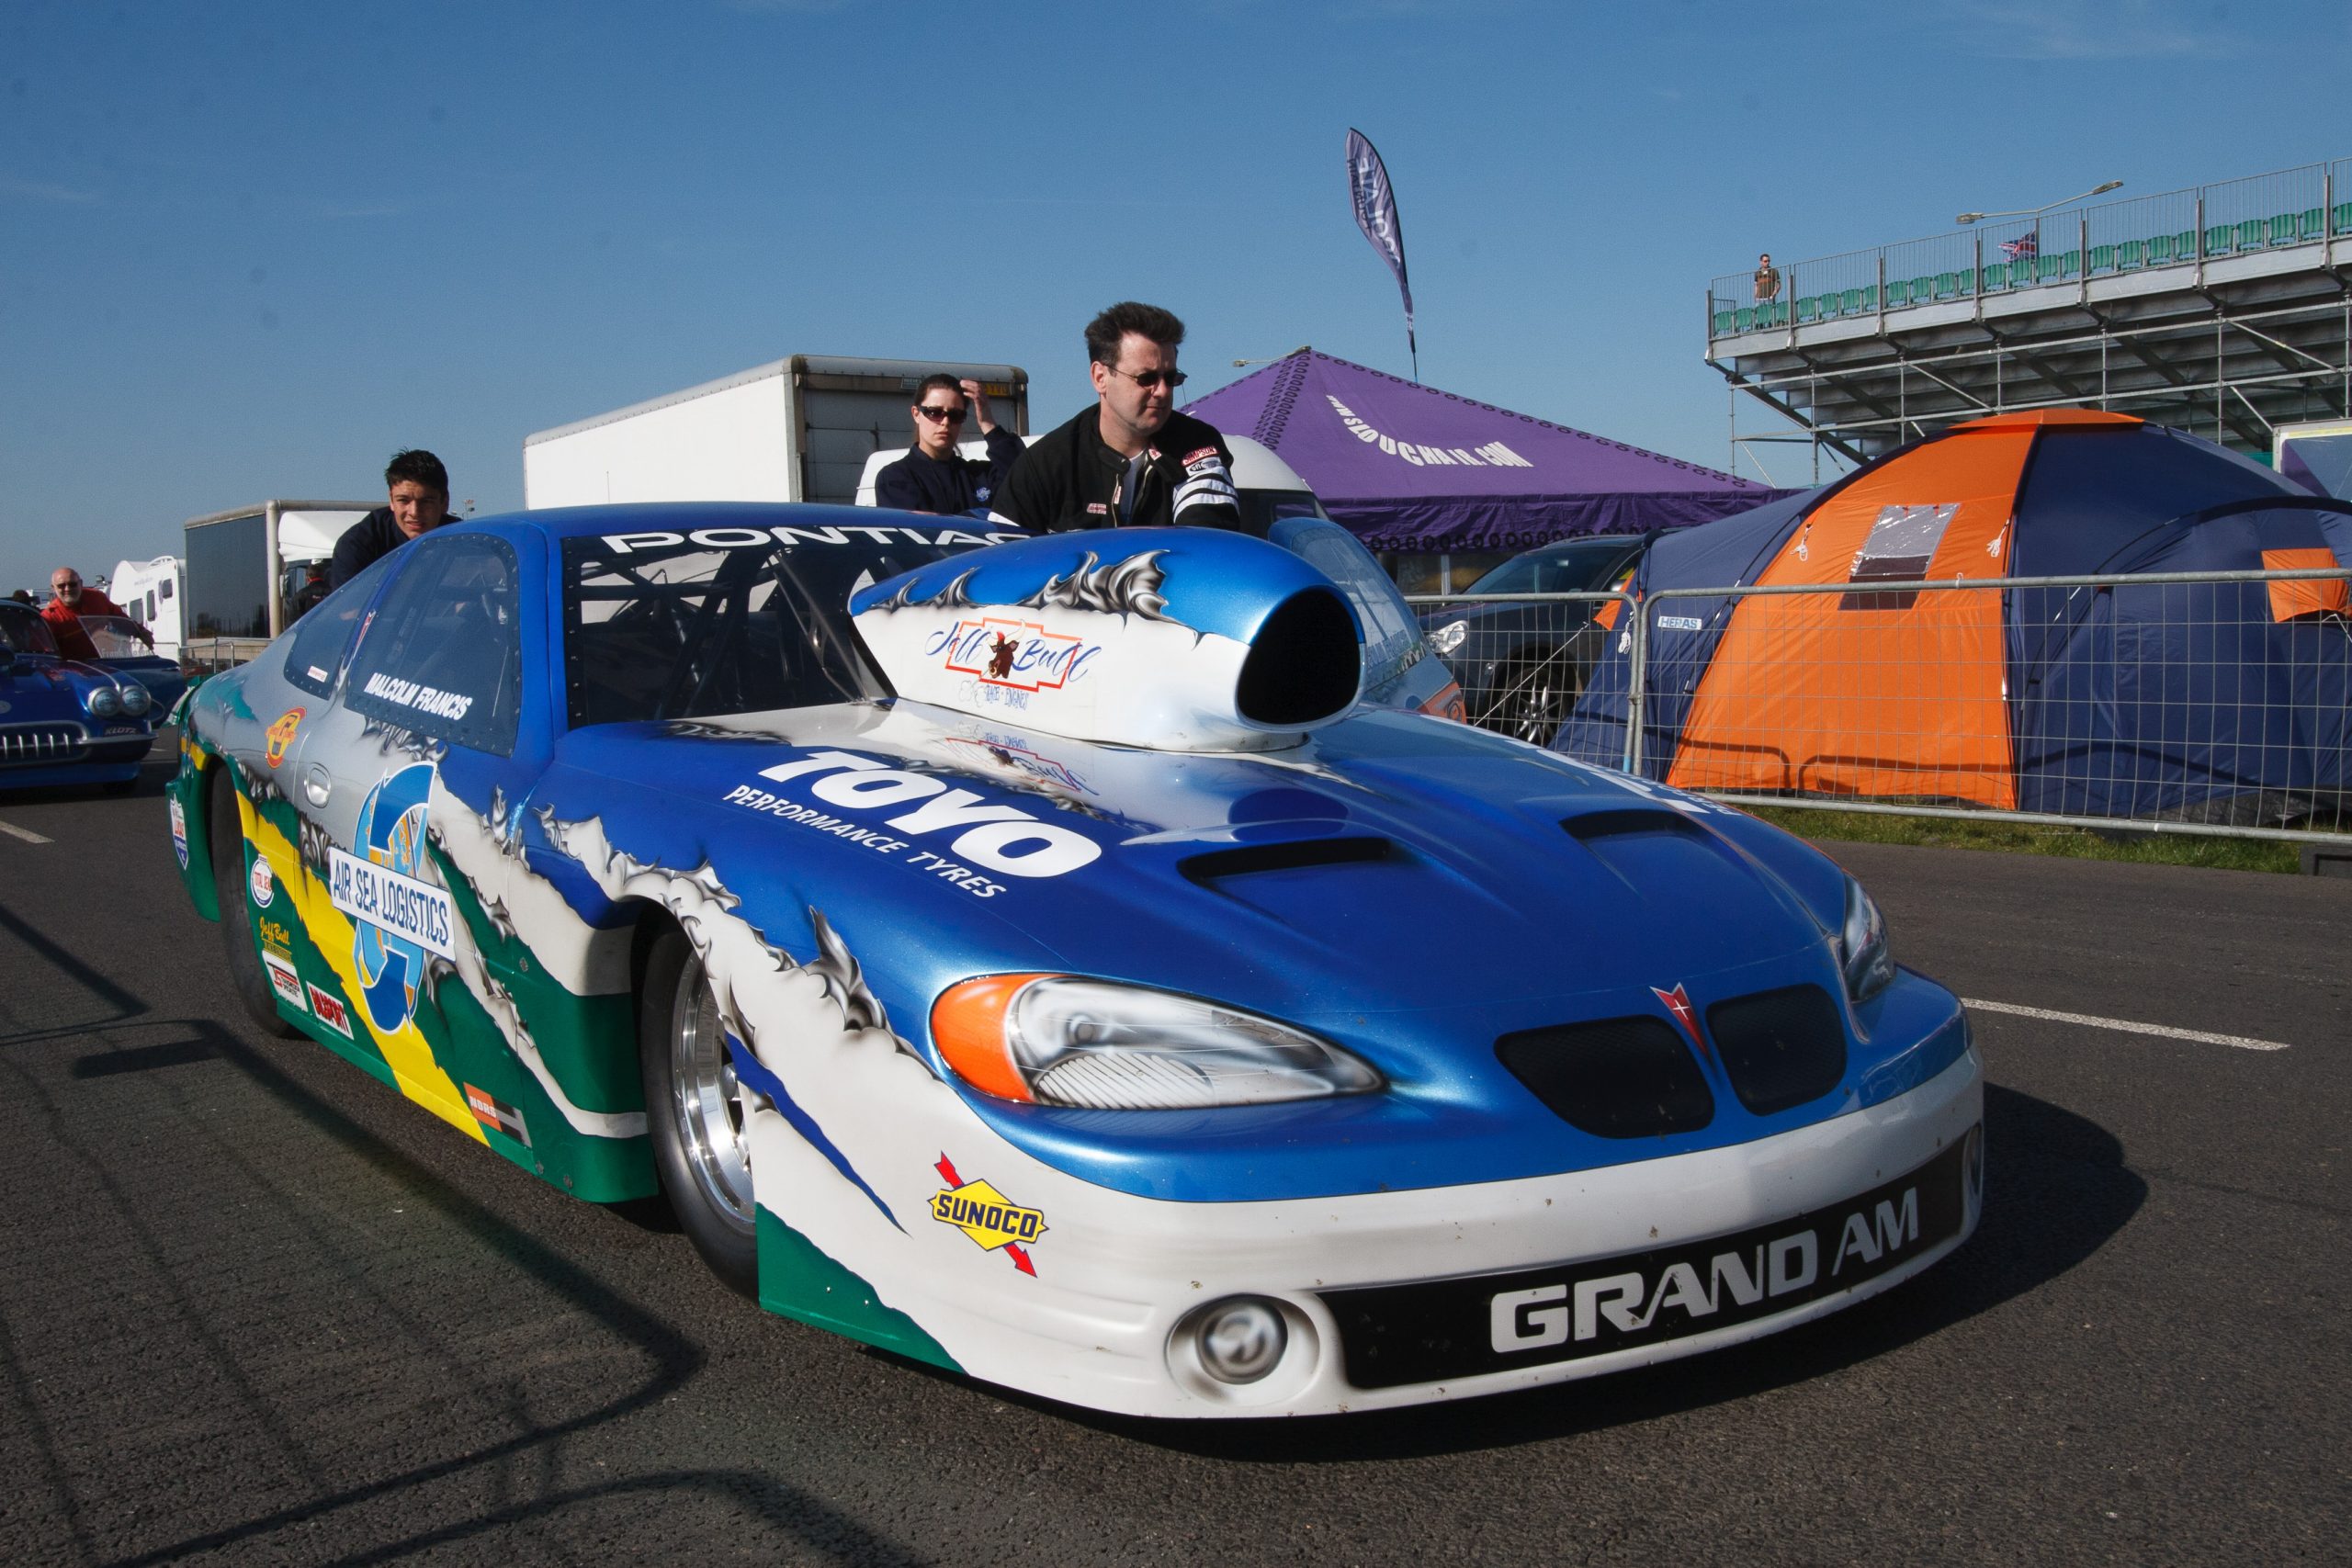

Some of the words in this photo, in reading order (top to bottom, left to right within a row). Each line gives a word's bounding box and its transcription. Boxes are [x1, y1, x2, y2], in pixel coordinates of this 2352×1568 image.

[1184, 446, 1216, 464] SIMPSON
[1660, 617, 1698, 629] HERAS
[1012, 639, 1102, 682] Bull
[364, 672, 421, 706] MALCOLM
[412, 686, 473, 721] FRANCIS
[105, 727, 137, 735] KLOTZ
[758, 750, 1102, 878] TOYO
[723, 784, 910, 854] PERFORMANCE
[907, 852, 1007, 898] TYRES
[334, 859, 351, 905] AIR
[355, 867, 378, 917] SEA
[382, 877, 449, 947] LOGISTICS
[936, 1193, 1038, 1238] SUNOCO
[1490, 1229, 1818, 1354] GRAND
[1832, 1187, 1919, 1277] AM
